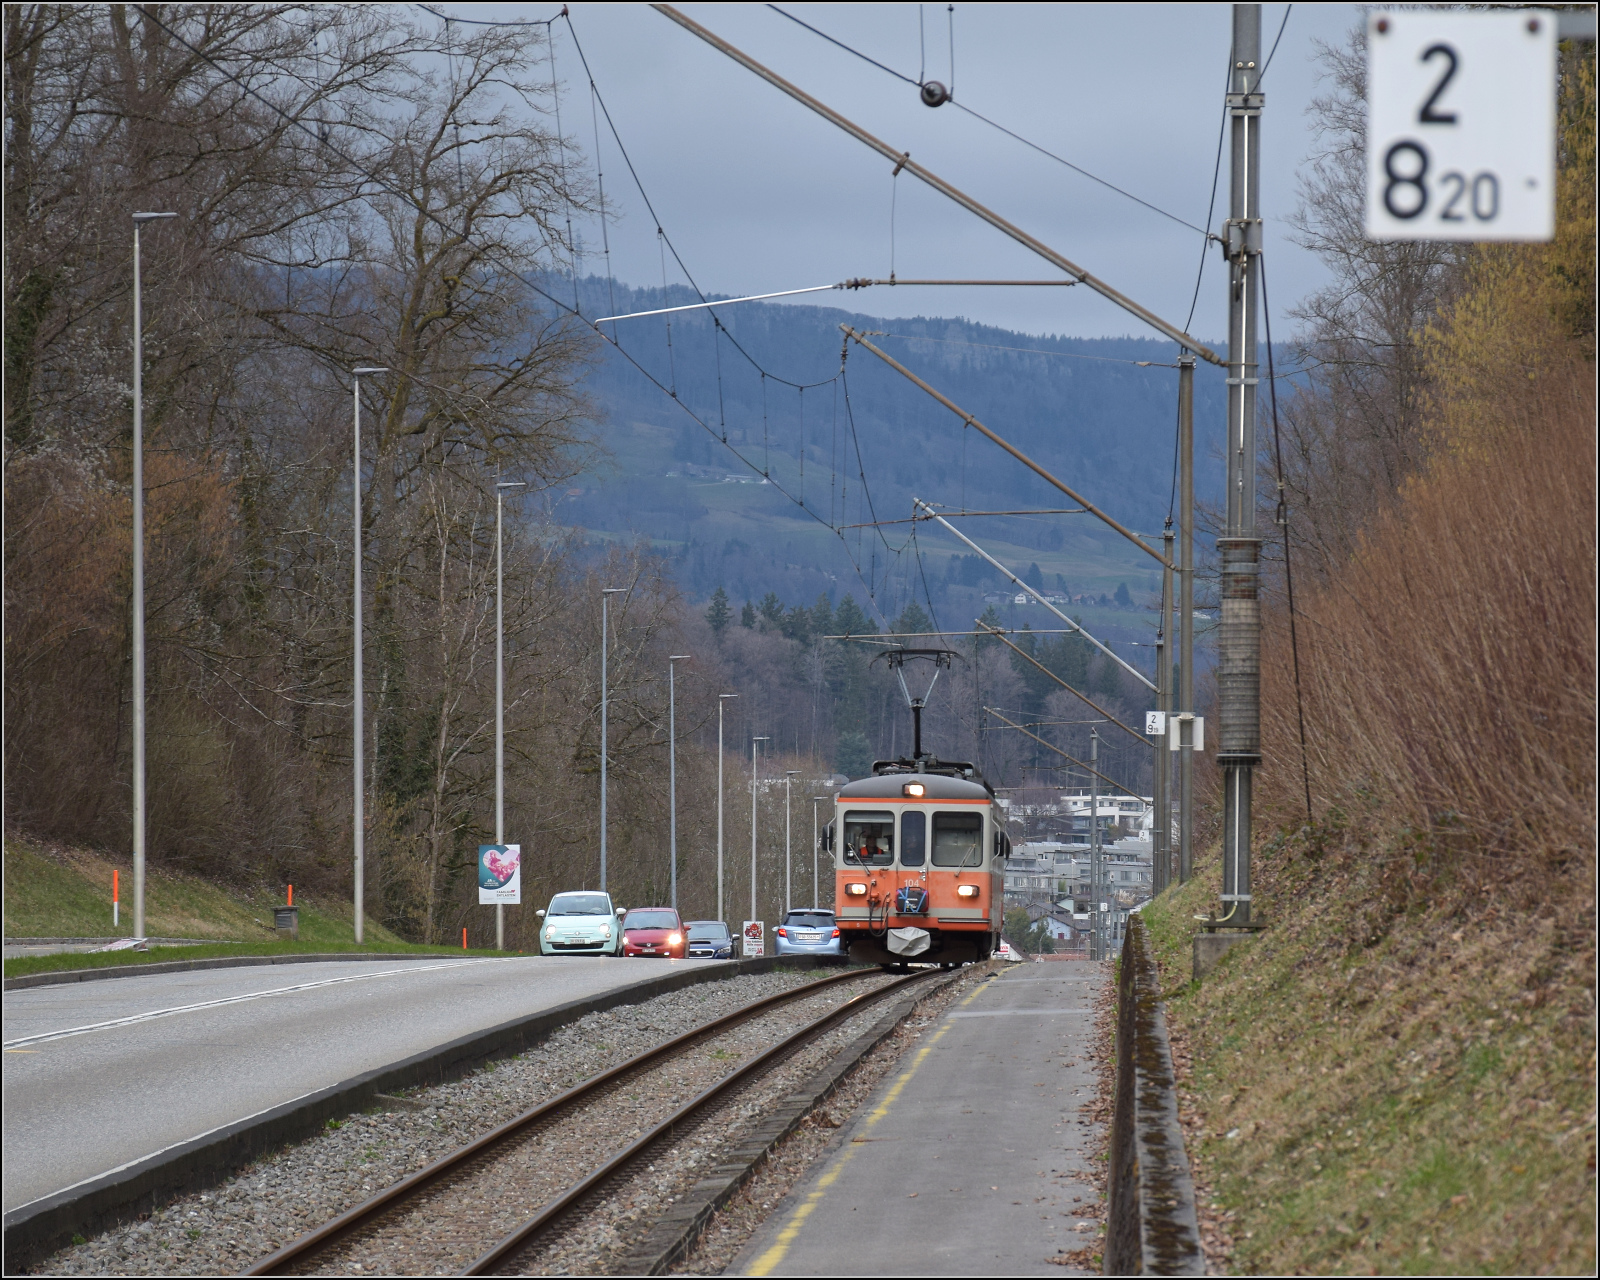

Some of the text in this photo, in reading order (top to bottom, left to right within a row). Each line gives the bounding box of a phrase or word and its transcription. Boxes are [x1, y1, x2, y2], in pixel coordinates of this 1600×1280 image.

[1417, 42, 1460, 125] 2
[1151, 714, 1157, 724] 2
[904, 879, 919, 888] 104
